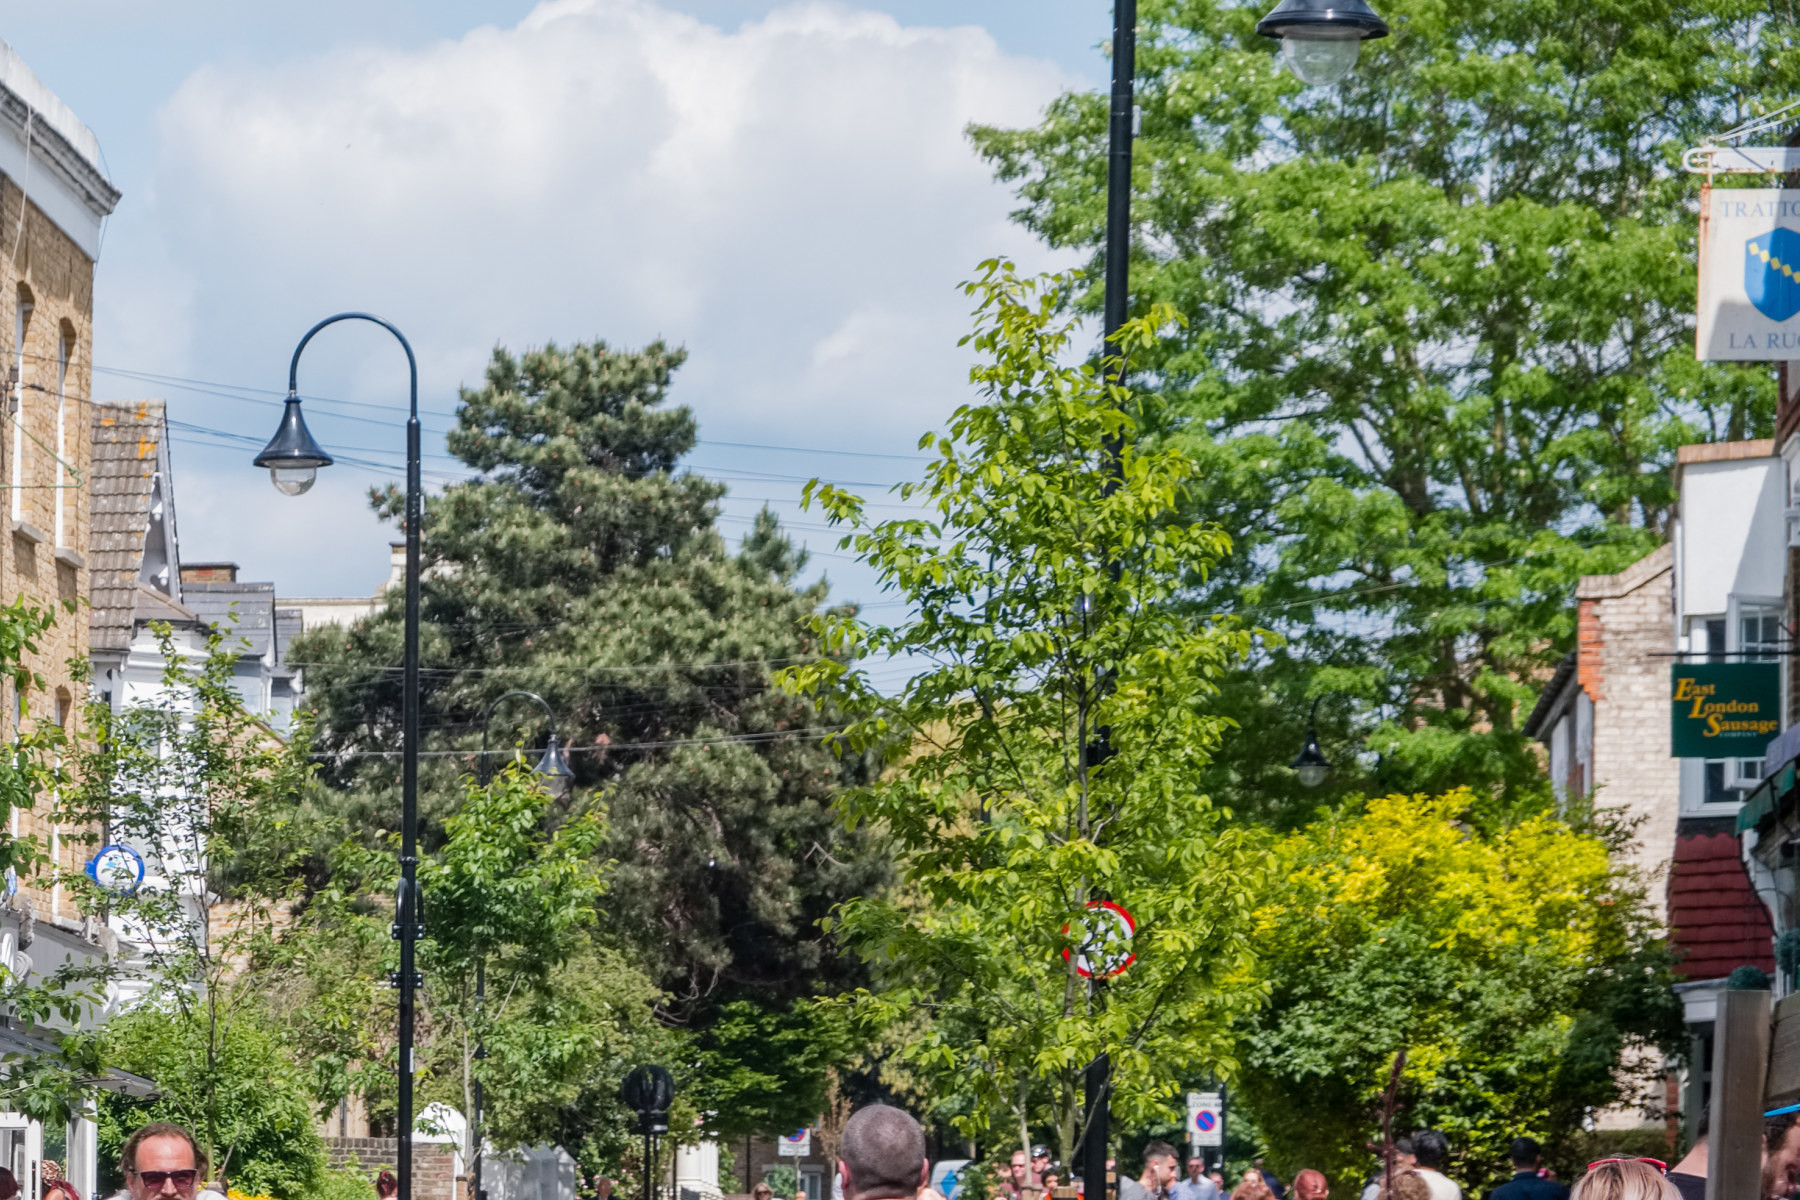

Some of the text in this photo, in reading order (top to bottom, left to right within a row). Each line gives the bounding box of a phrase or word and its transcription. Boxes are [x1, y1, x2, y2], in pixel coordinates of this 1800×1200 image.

[1729, 331, 1758, 350] LA
[1672, 677, 1716, 701] East
[1687, 695, 1759, 719] London
[1702, 712, 1778, 738] Sausage
